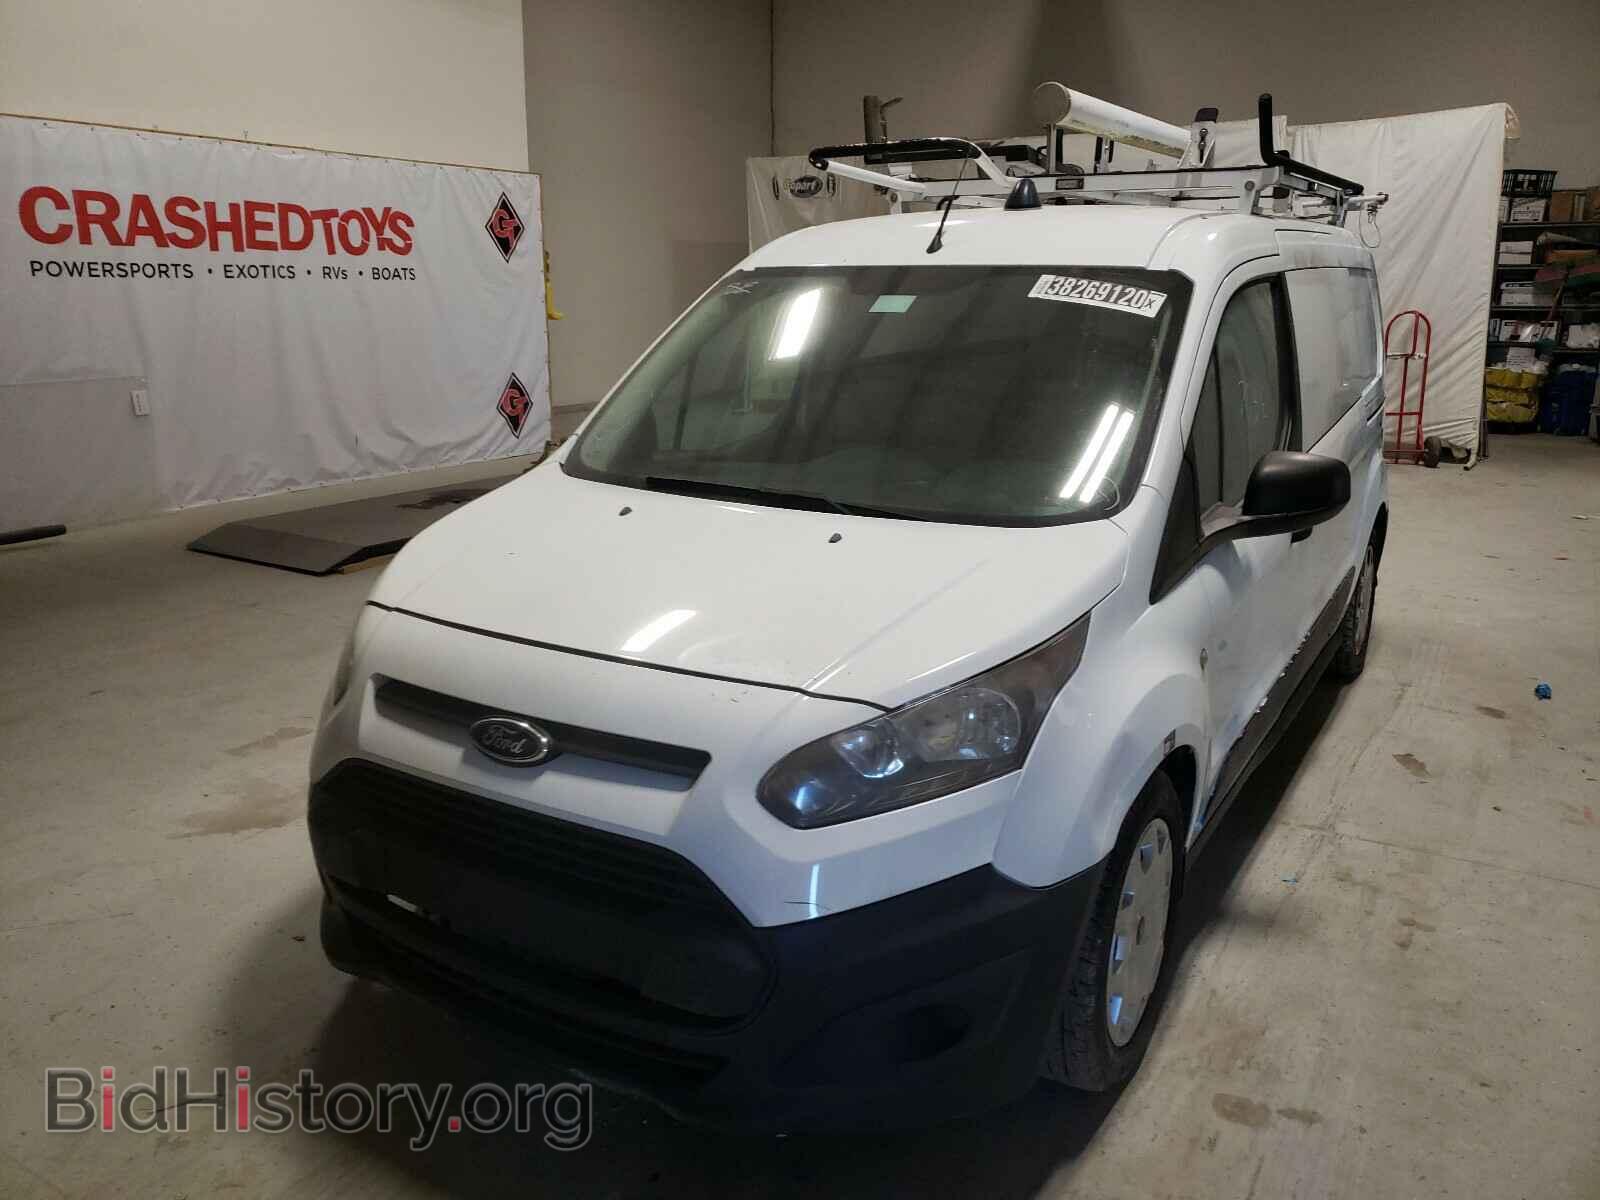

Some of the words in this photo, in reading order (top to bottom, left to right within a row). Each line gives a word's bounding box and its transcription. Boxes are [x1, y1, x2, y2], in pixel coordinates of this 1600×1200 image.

[19, 186, 415, 256] CRASHEDTOYS
[30, 260, 194, 279] POWERSPORTS
[223, 264, 296, 279] EXOTICS
[322, 267, 348, 280] RVs
[372, 267, 415, 280] BOATS
[1047, 277, 1147, 308] 38269120
[485, 725, 527, 753] Ford
